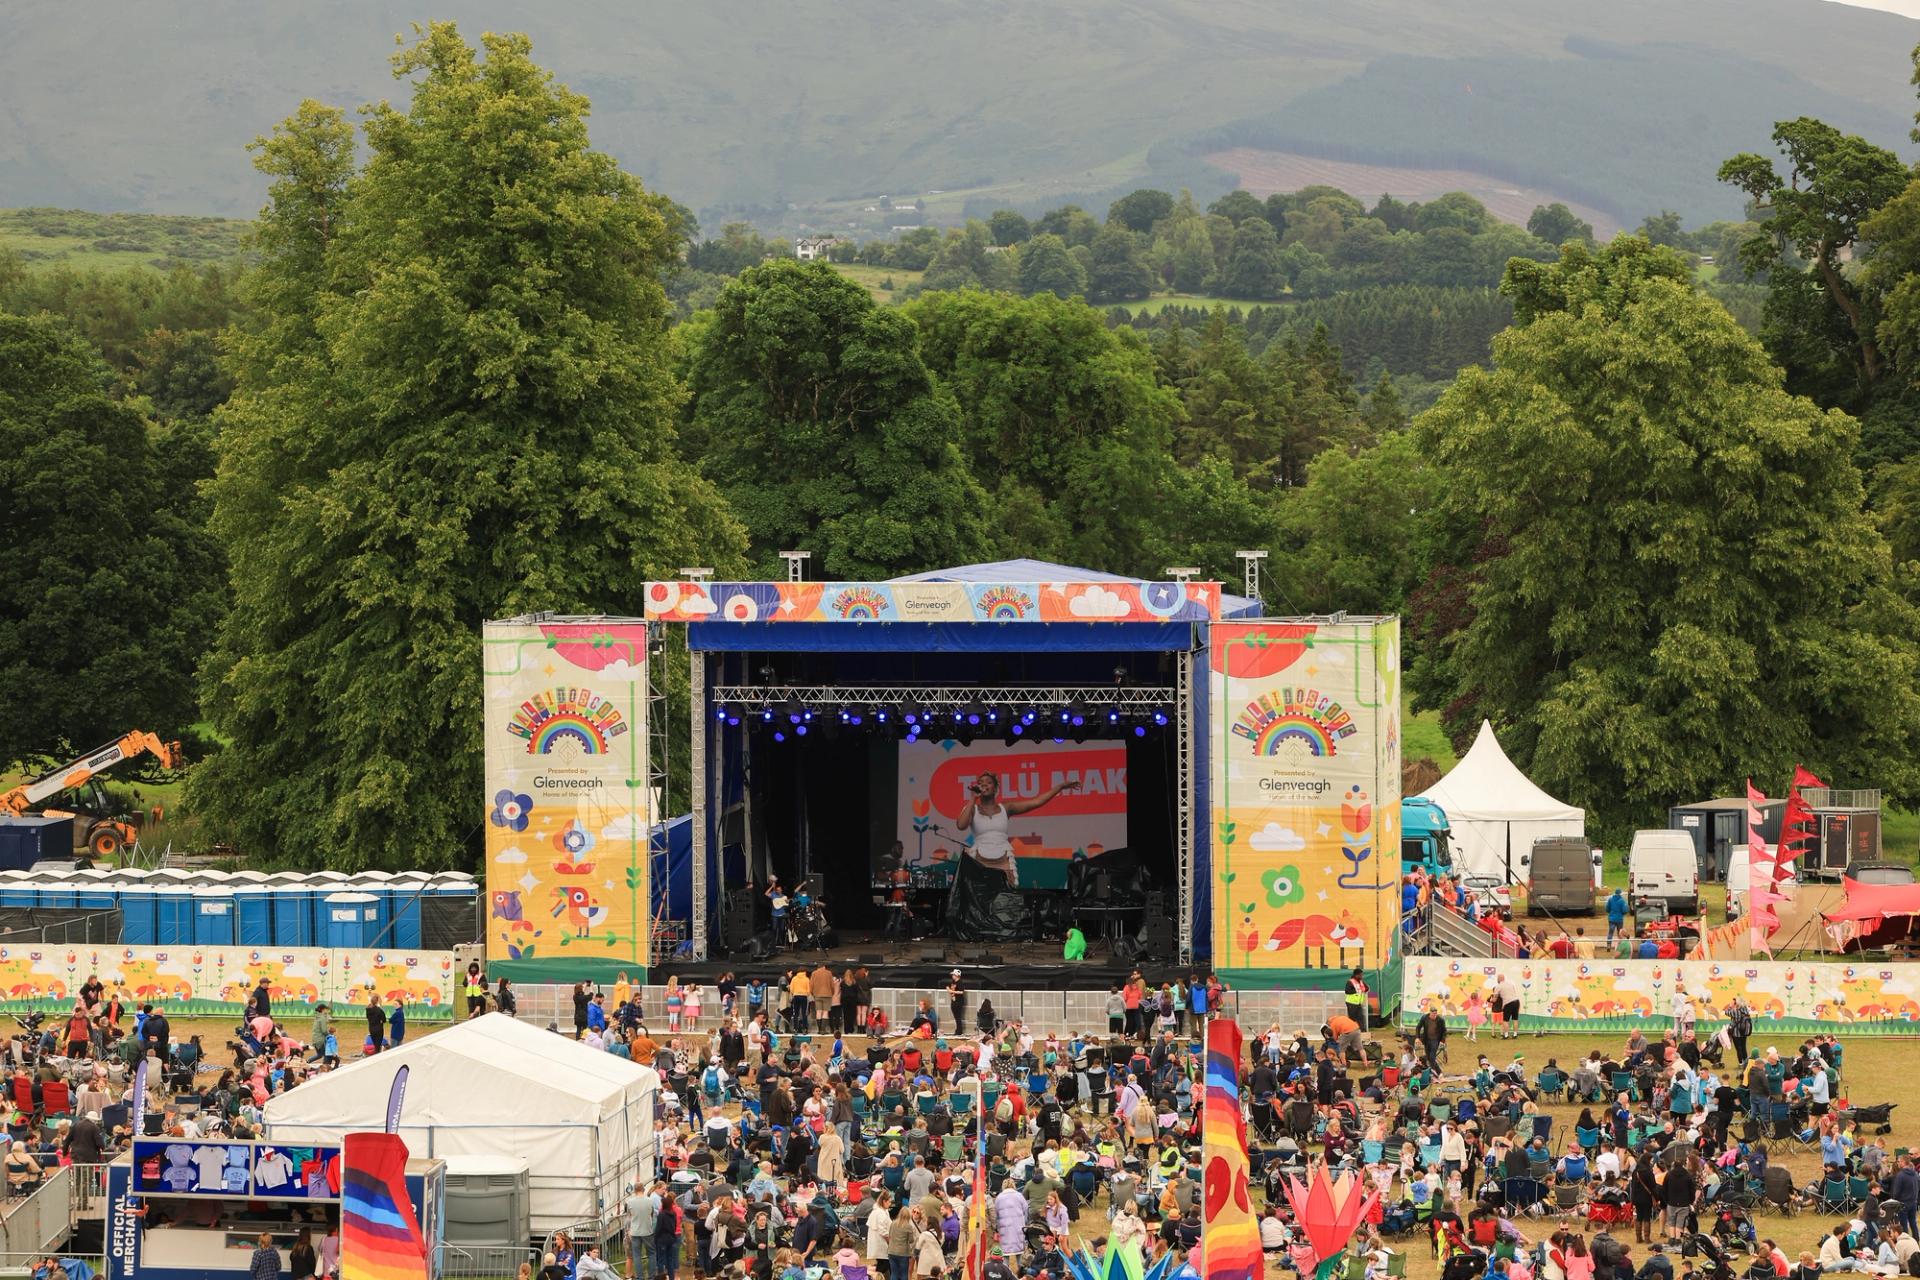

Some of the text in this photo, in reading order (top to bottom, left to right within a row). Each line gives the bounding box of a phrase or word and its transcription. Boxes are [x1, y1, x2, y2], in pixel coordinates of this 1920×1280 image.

[905, 600, 951, 610] Glenveagh
[1232, 688, 1357, 738] KALEIDOSCOPE
[1273, 769, 1306, 777] Presented
[533, 776, 603, 791] Glenveagh
[958, 762, 1040, 801] TLÜ
[1259, 778, 1331, 794] Glenveagh
[113, 1194, 125, 1257] OFFICIAL
